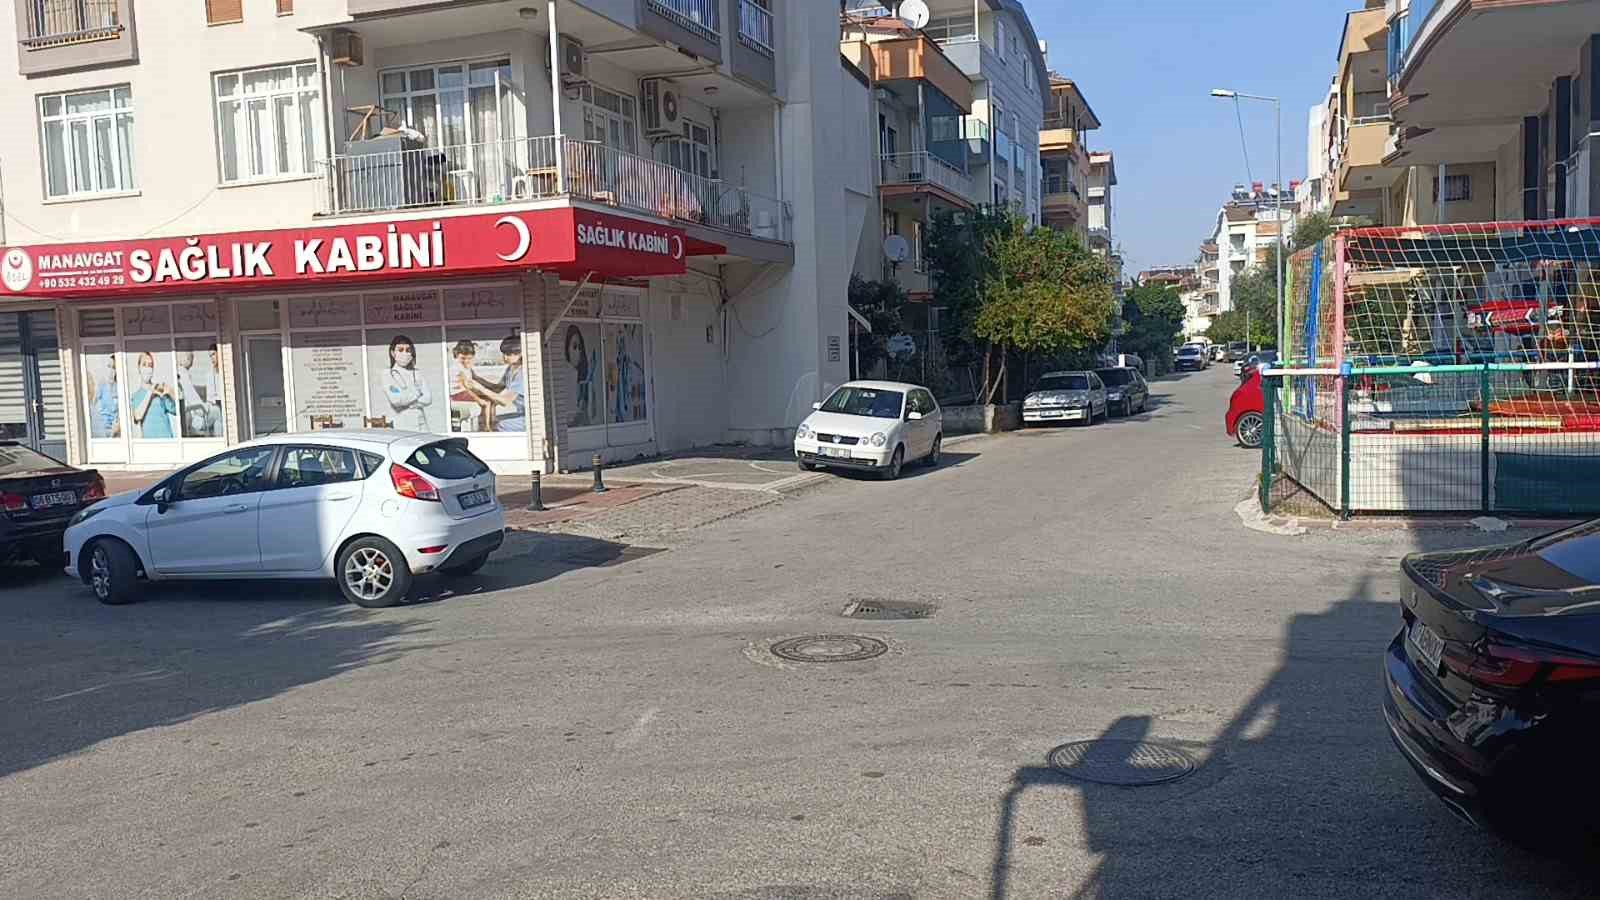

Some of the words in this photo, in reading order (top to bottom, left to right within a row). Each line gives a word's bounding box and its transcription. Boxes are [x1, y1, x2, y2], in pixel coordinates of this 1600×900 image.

[577, 222, 625, 249] SAĞLIK
[628, 228, 669, 255] KABİNİ
[38, 251, 124, 269] MANAVGAT
[129, 238, 274, 283] SAĞLIK
[293, 221, 445, 274] KABİNİ
[39, 278, 56, 288] +90
[58, 278, 76, 288] 532
[78, 276, 96, 287] 432
[97, 276, 110, 286] 49
[112, 275, 124, 285] 29
